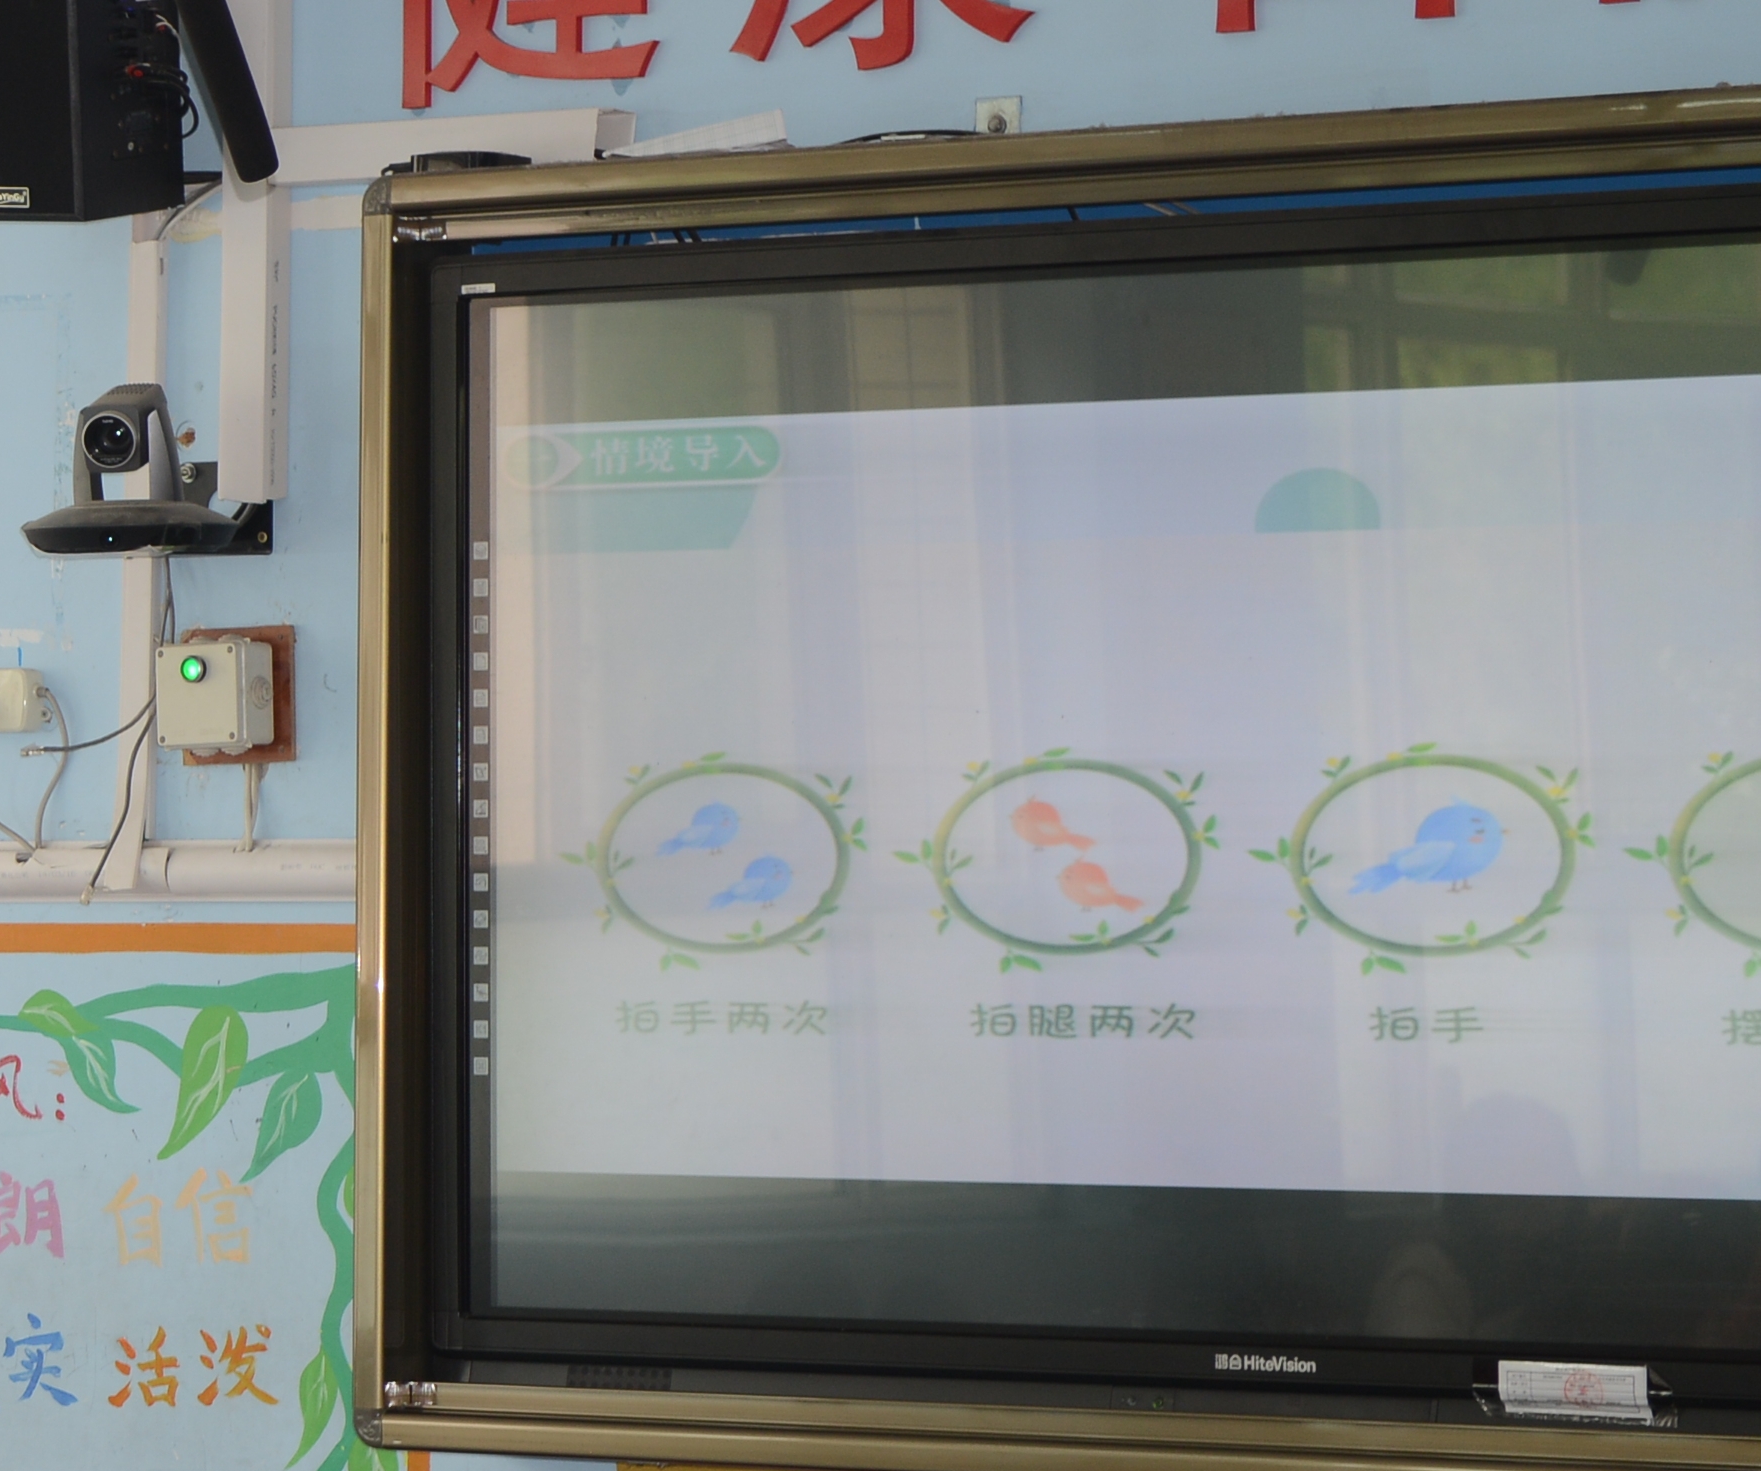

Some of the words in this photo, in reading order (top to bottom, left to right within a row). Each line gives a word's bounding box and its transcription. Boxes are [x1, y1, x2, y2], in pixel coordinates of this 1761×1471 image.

[590, 435, 767, 476] 情境导入
[615, 1000, 829, 1037] 拍手两次
[970, 1003, 1195, 1040] 拍腿两次
[1370, 1005, 1484, 1044] 拍手
[103, 1167, 253, 1269] 自信
[107, 1324, 279, 1408] 活泼
[1243, 1354, 1317, 1374] HiteVision
